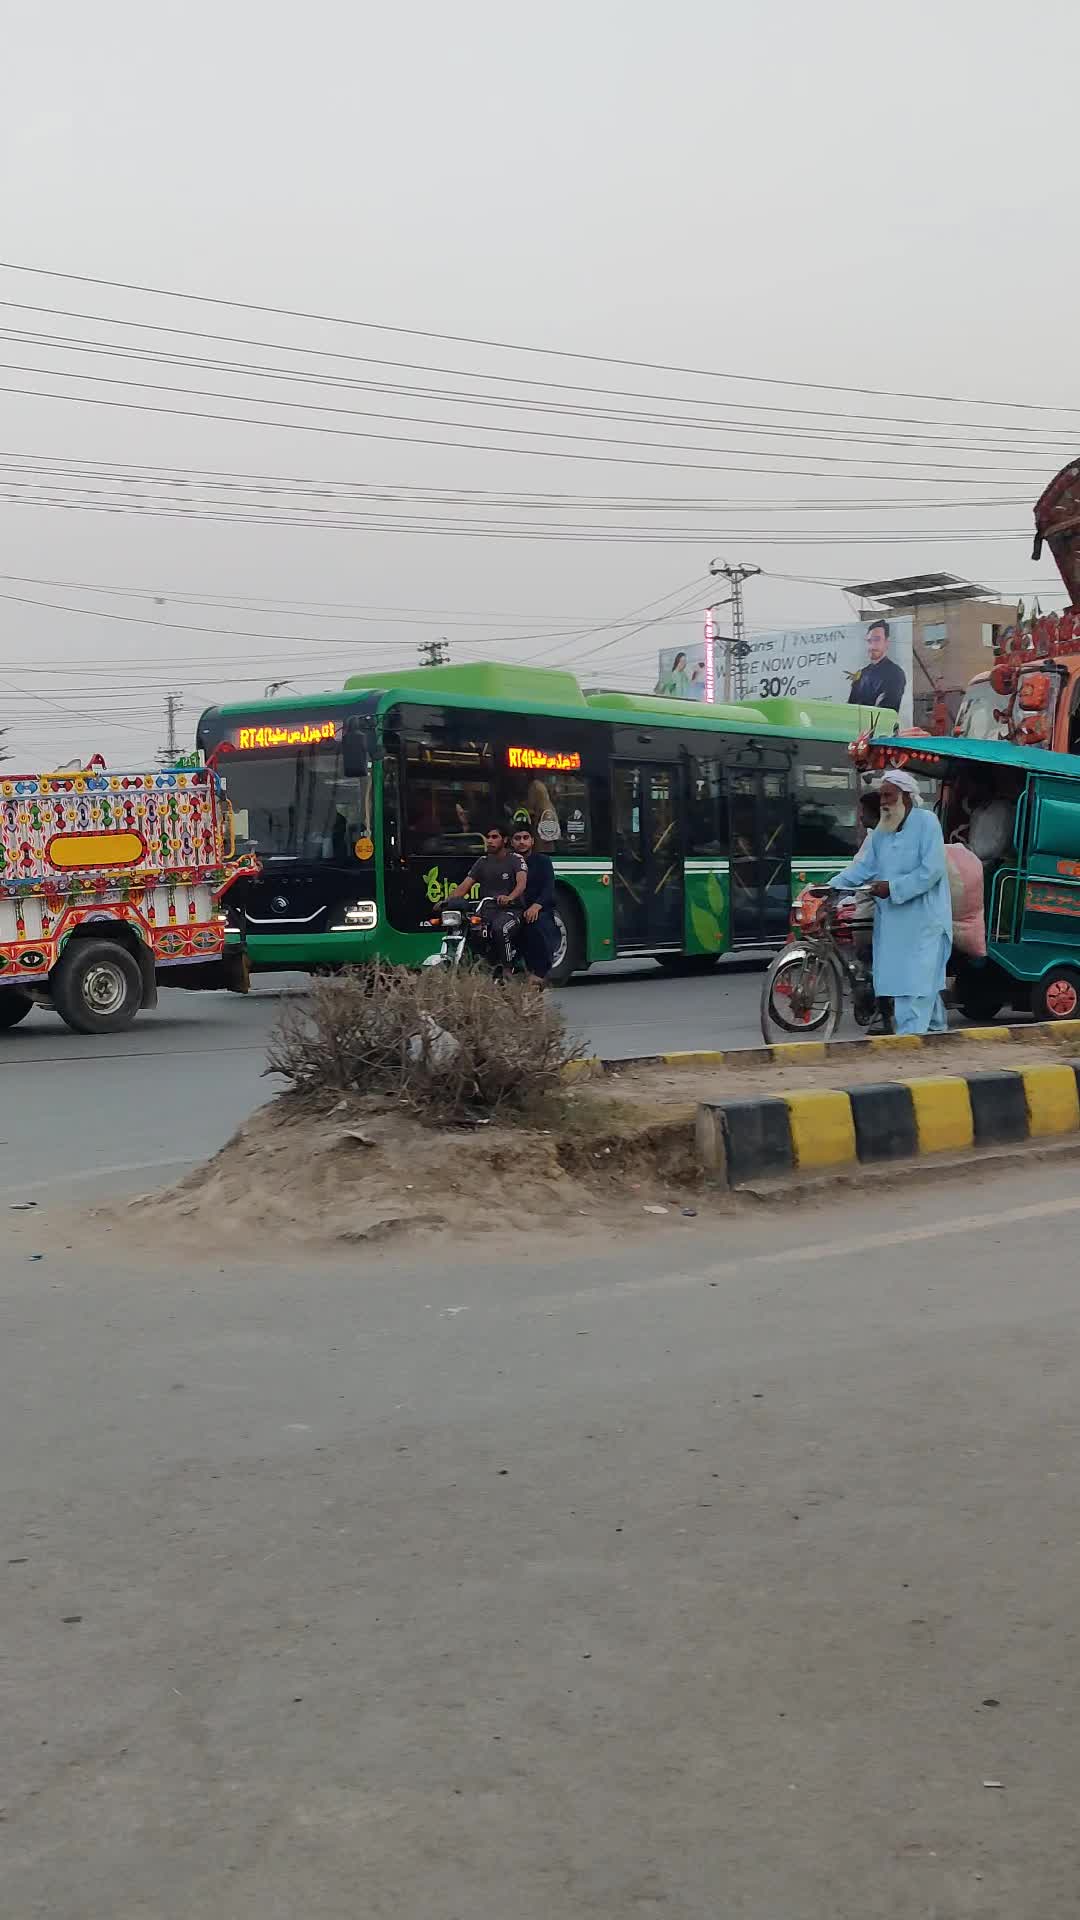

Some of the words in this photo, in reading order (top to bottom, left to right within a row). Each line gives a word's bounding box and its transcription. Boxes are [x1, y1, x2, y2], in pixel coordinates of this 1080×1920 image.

[761, 655, 796, 672] NOW
[796, 652, 838, 669] OPEN
[759, 676, 798, 699] 30%
